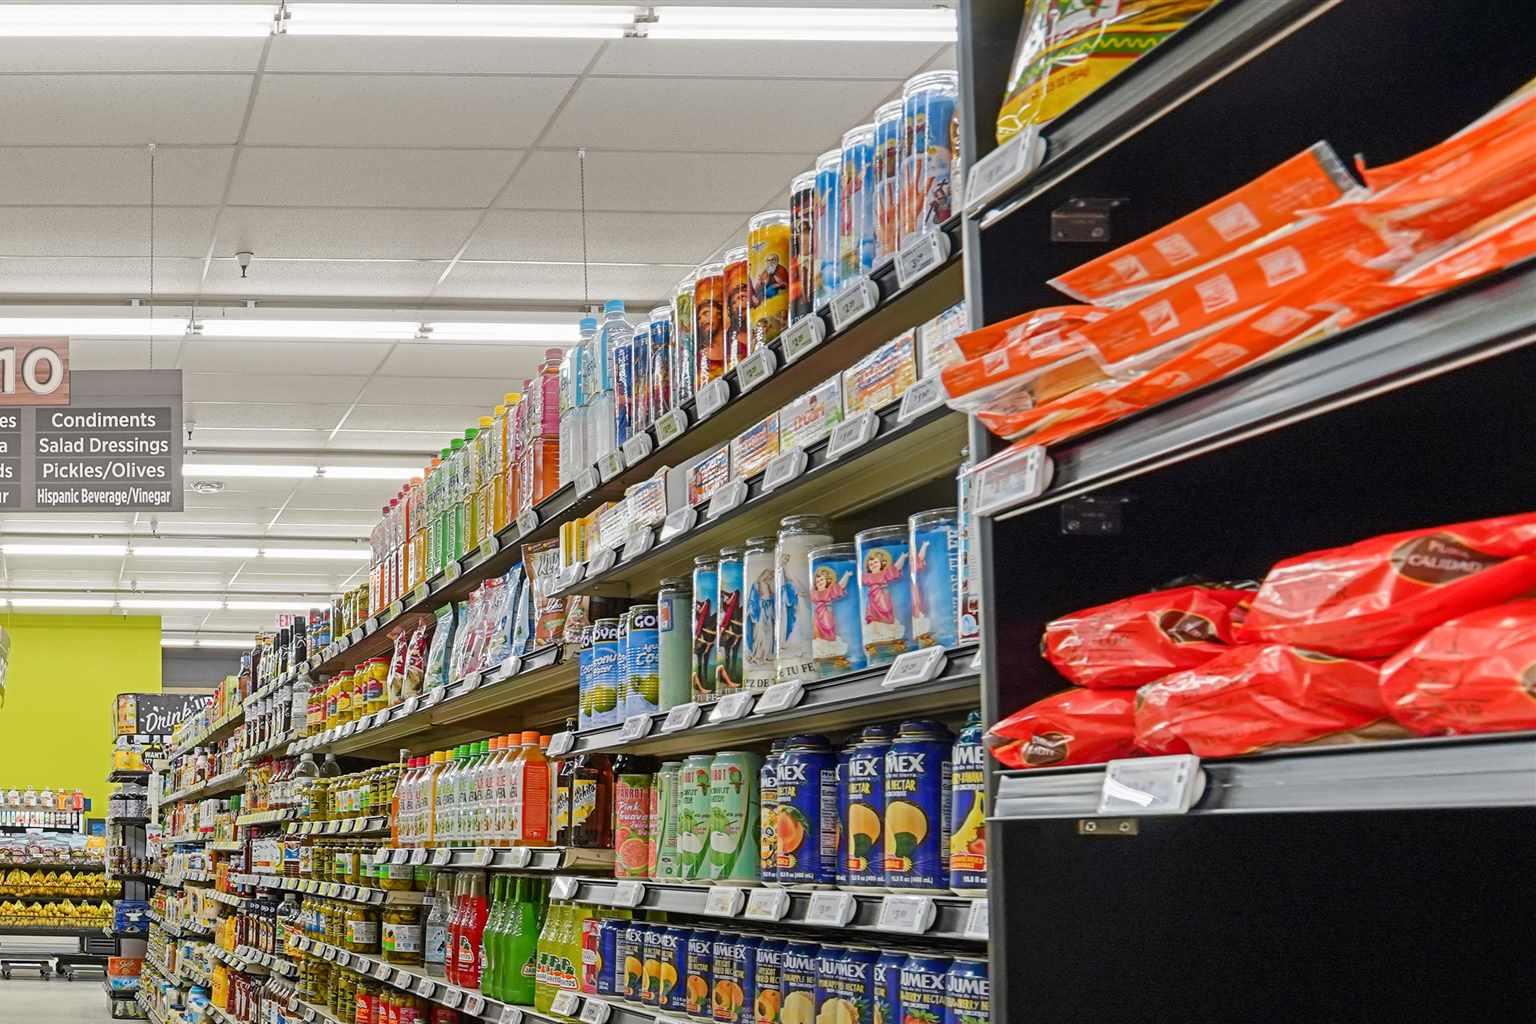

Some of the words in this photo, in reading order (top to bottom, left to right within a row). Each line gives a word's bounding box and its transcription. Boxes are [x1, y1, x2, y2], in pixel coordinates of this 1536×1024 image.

[51, 412, 156, 428] Condiments
[39, 438, 86, 453] Salad
[89, 437, 169, 456] Dressings
[43, 462, 166, 480] Pickles/Olives
[37, 488, 79, 506] Hispanic
[81, 487, 171, 506] Beverage/Vinegar
[1405, 550, 1483, 576] CALIDAD
[145, 702, 190, 734] Drink
[777, 762, 807, 782] MEX
[849, 756, 880, 777] MEX
[885, 752, 925, 774] MEX
[947, 975, 991, 996] JUME
